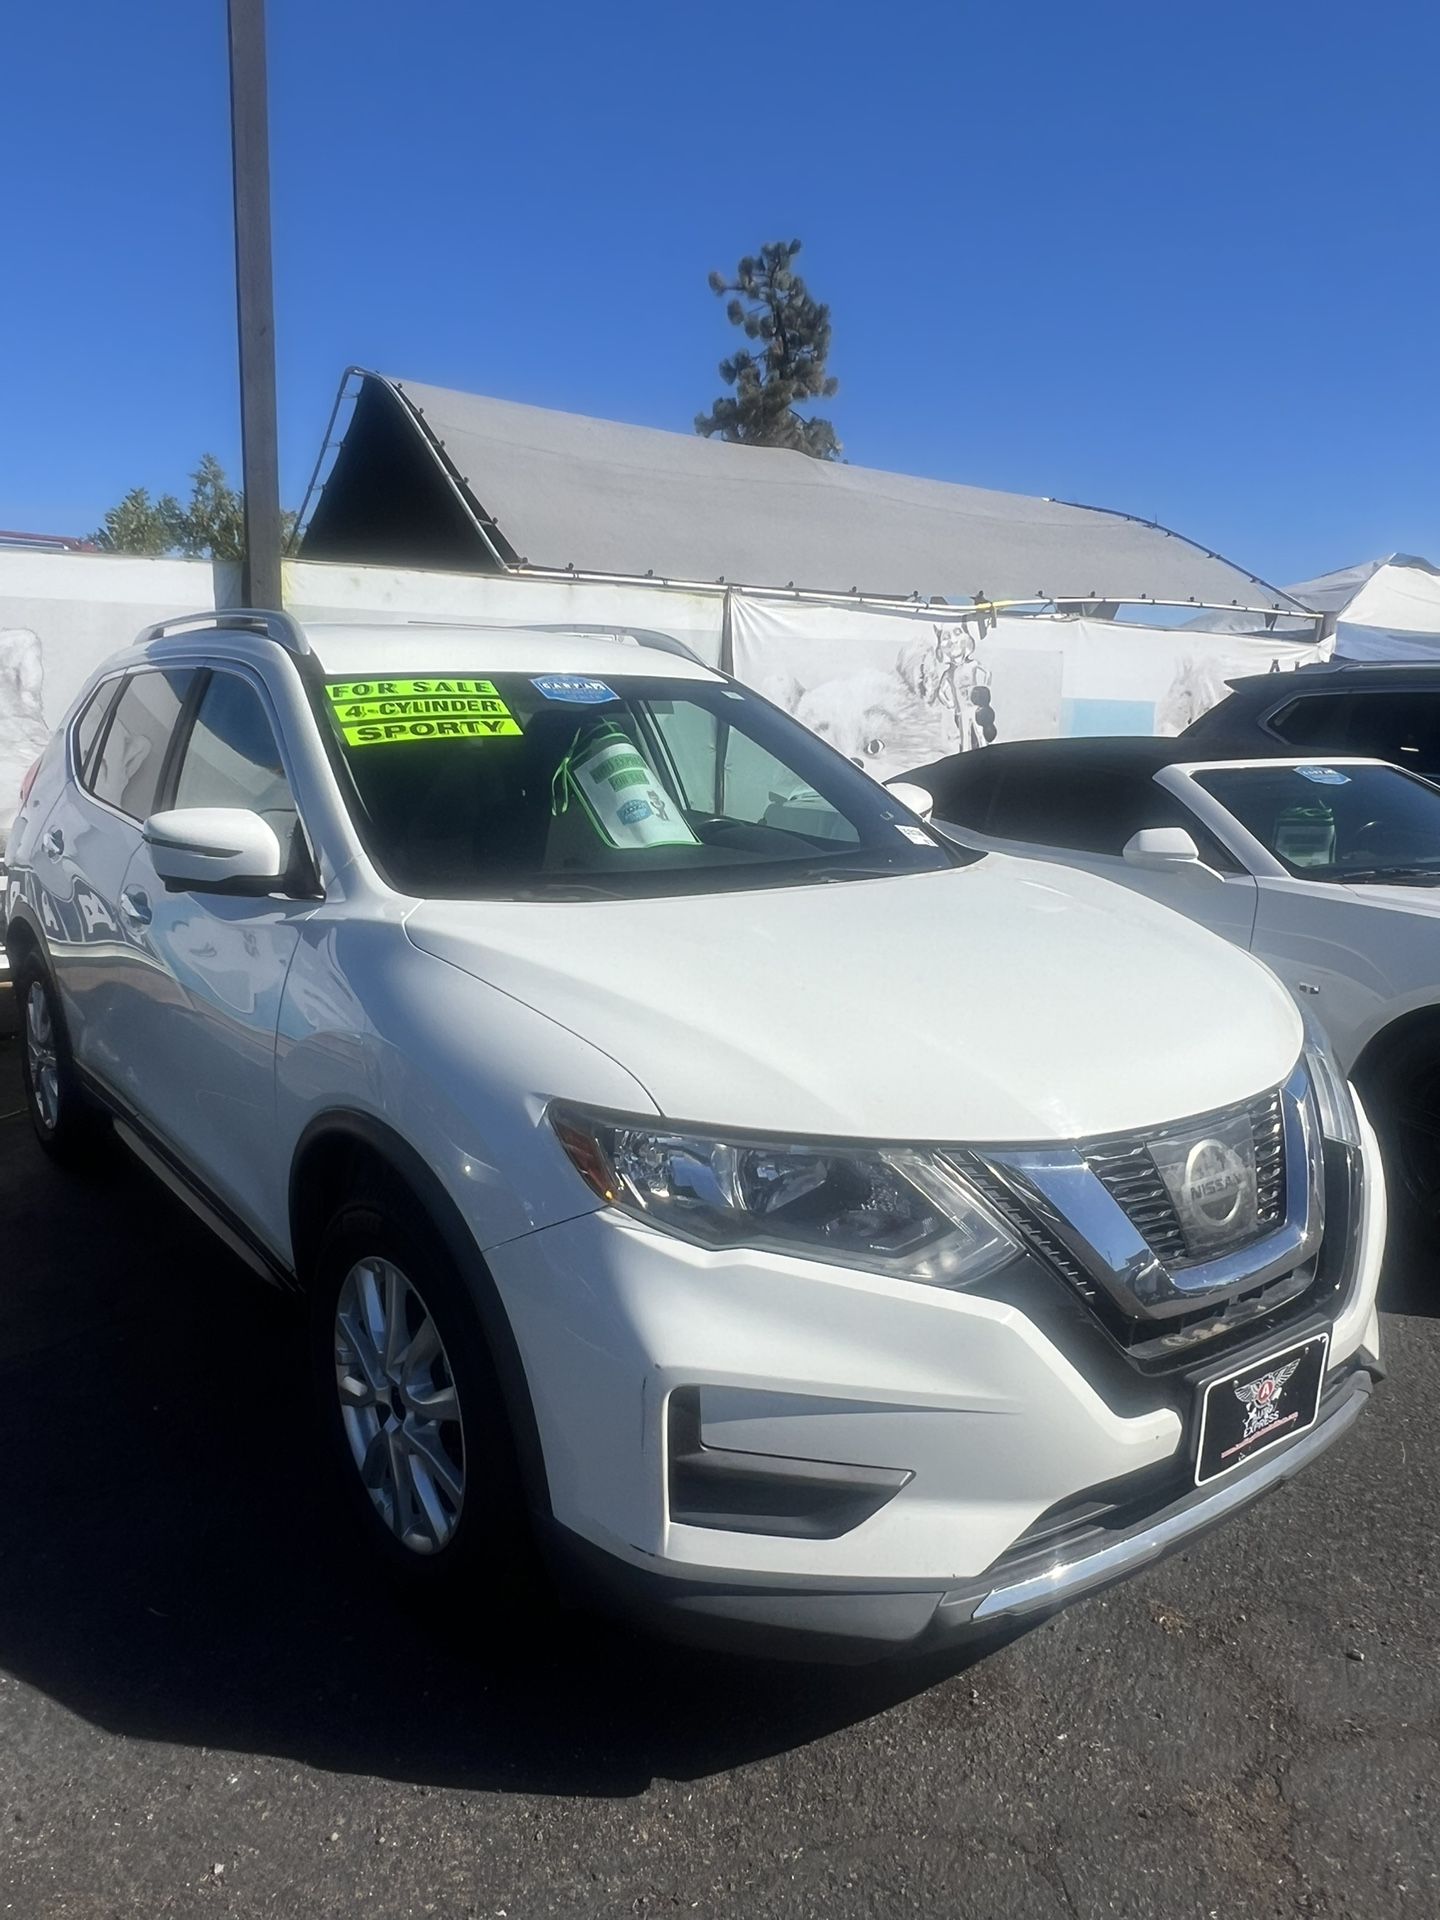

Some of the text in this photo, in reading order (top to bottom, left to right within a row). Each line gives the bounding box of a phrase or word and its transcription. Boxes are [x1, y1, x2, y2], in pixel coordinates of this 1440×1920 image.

[332, 681, 492, 698] FOR SALE
[345, 700, 499, 718] 4-CYLINDER
[357, 720, 502, 741] SPORTY
[1191, 1173, 1242, 1200] NISSAN
[1243, 1410, 1280, 1438] EXPRESS
